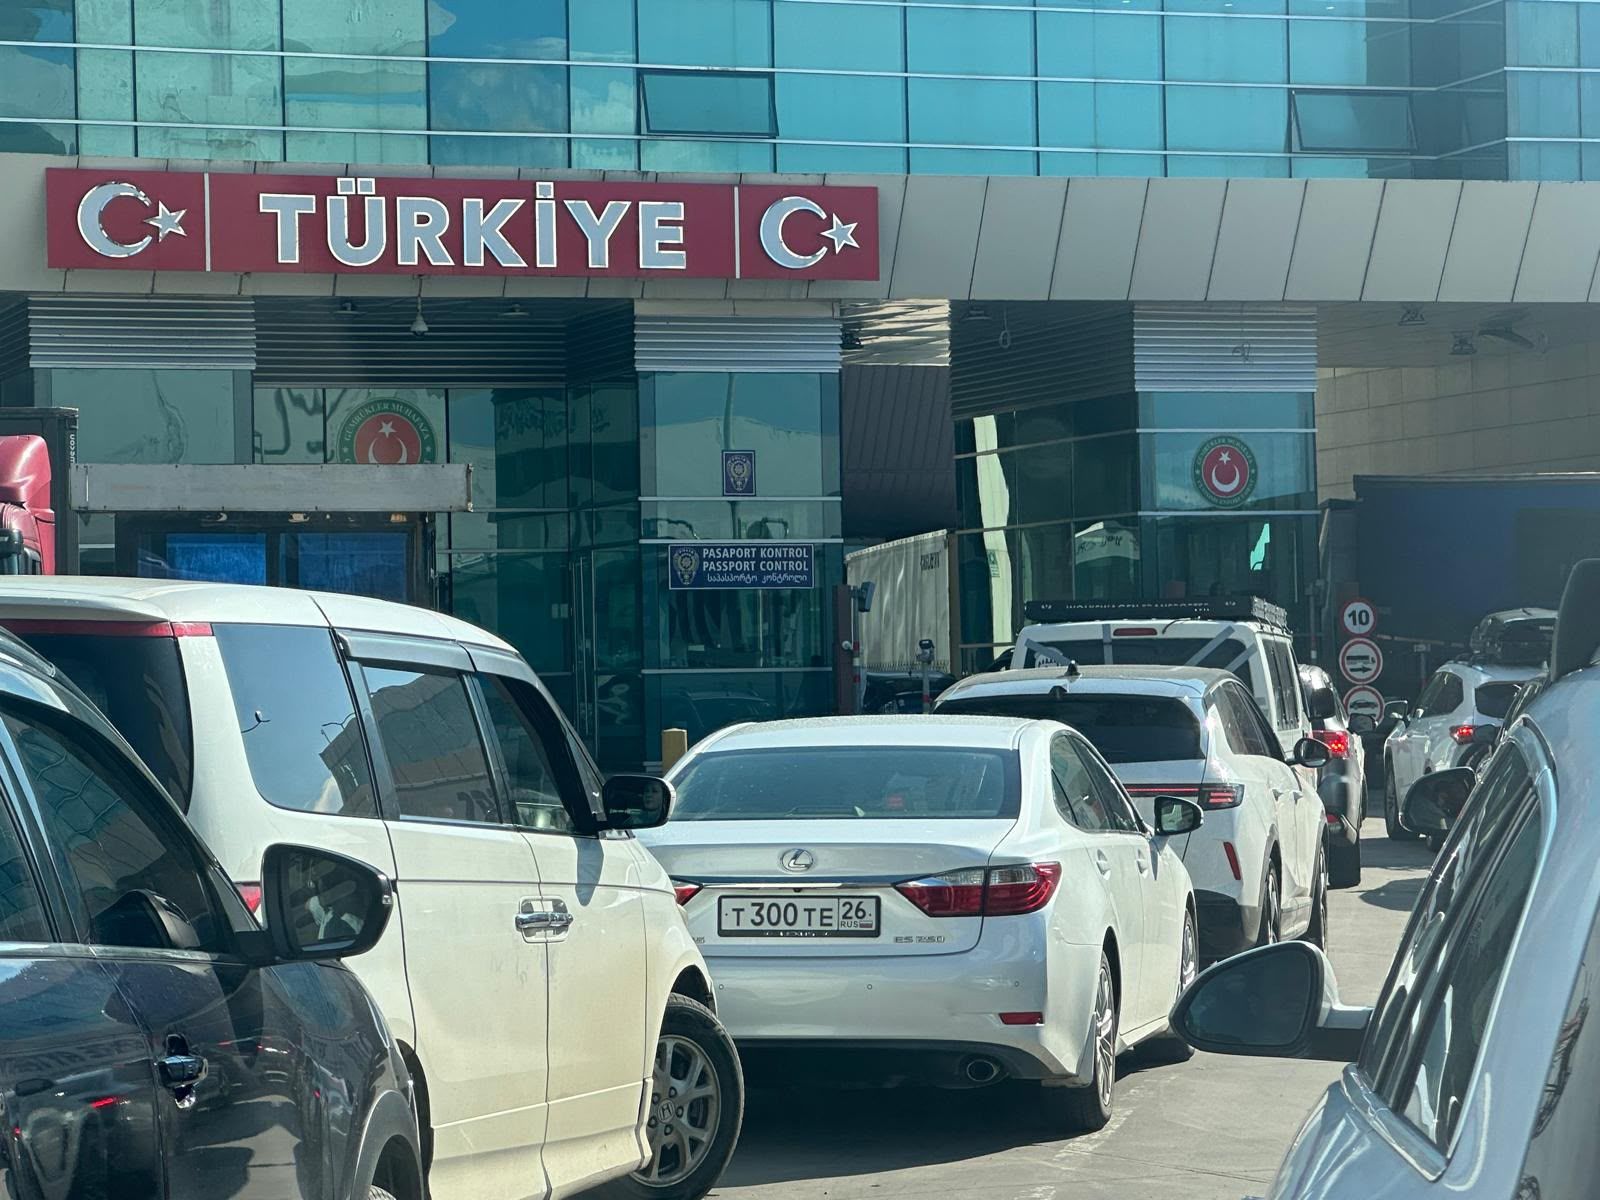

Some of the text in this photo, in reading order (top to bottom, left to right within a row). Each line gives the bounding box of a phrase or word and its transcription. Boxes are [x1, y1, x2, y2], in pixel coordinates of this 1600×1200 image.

[259, 177, 687, 270] TÜRKİYE
[702, 547, 757, 559] PASAPORT
[760, 547, 809, 558] KONTROL
[703, 560, 809, 571] PASSPORT CONTROL
[1348, 609, 1370, 626] 10
[841, 901, 867, 920] 26
[840, 920, 859, 929] RUS
